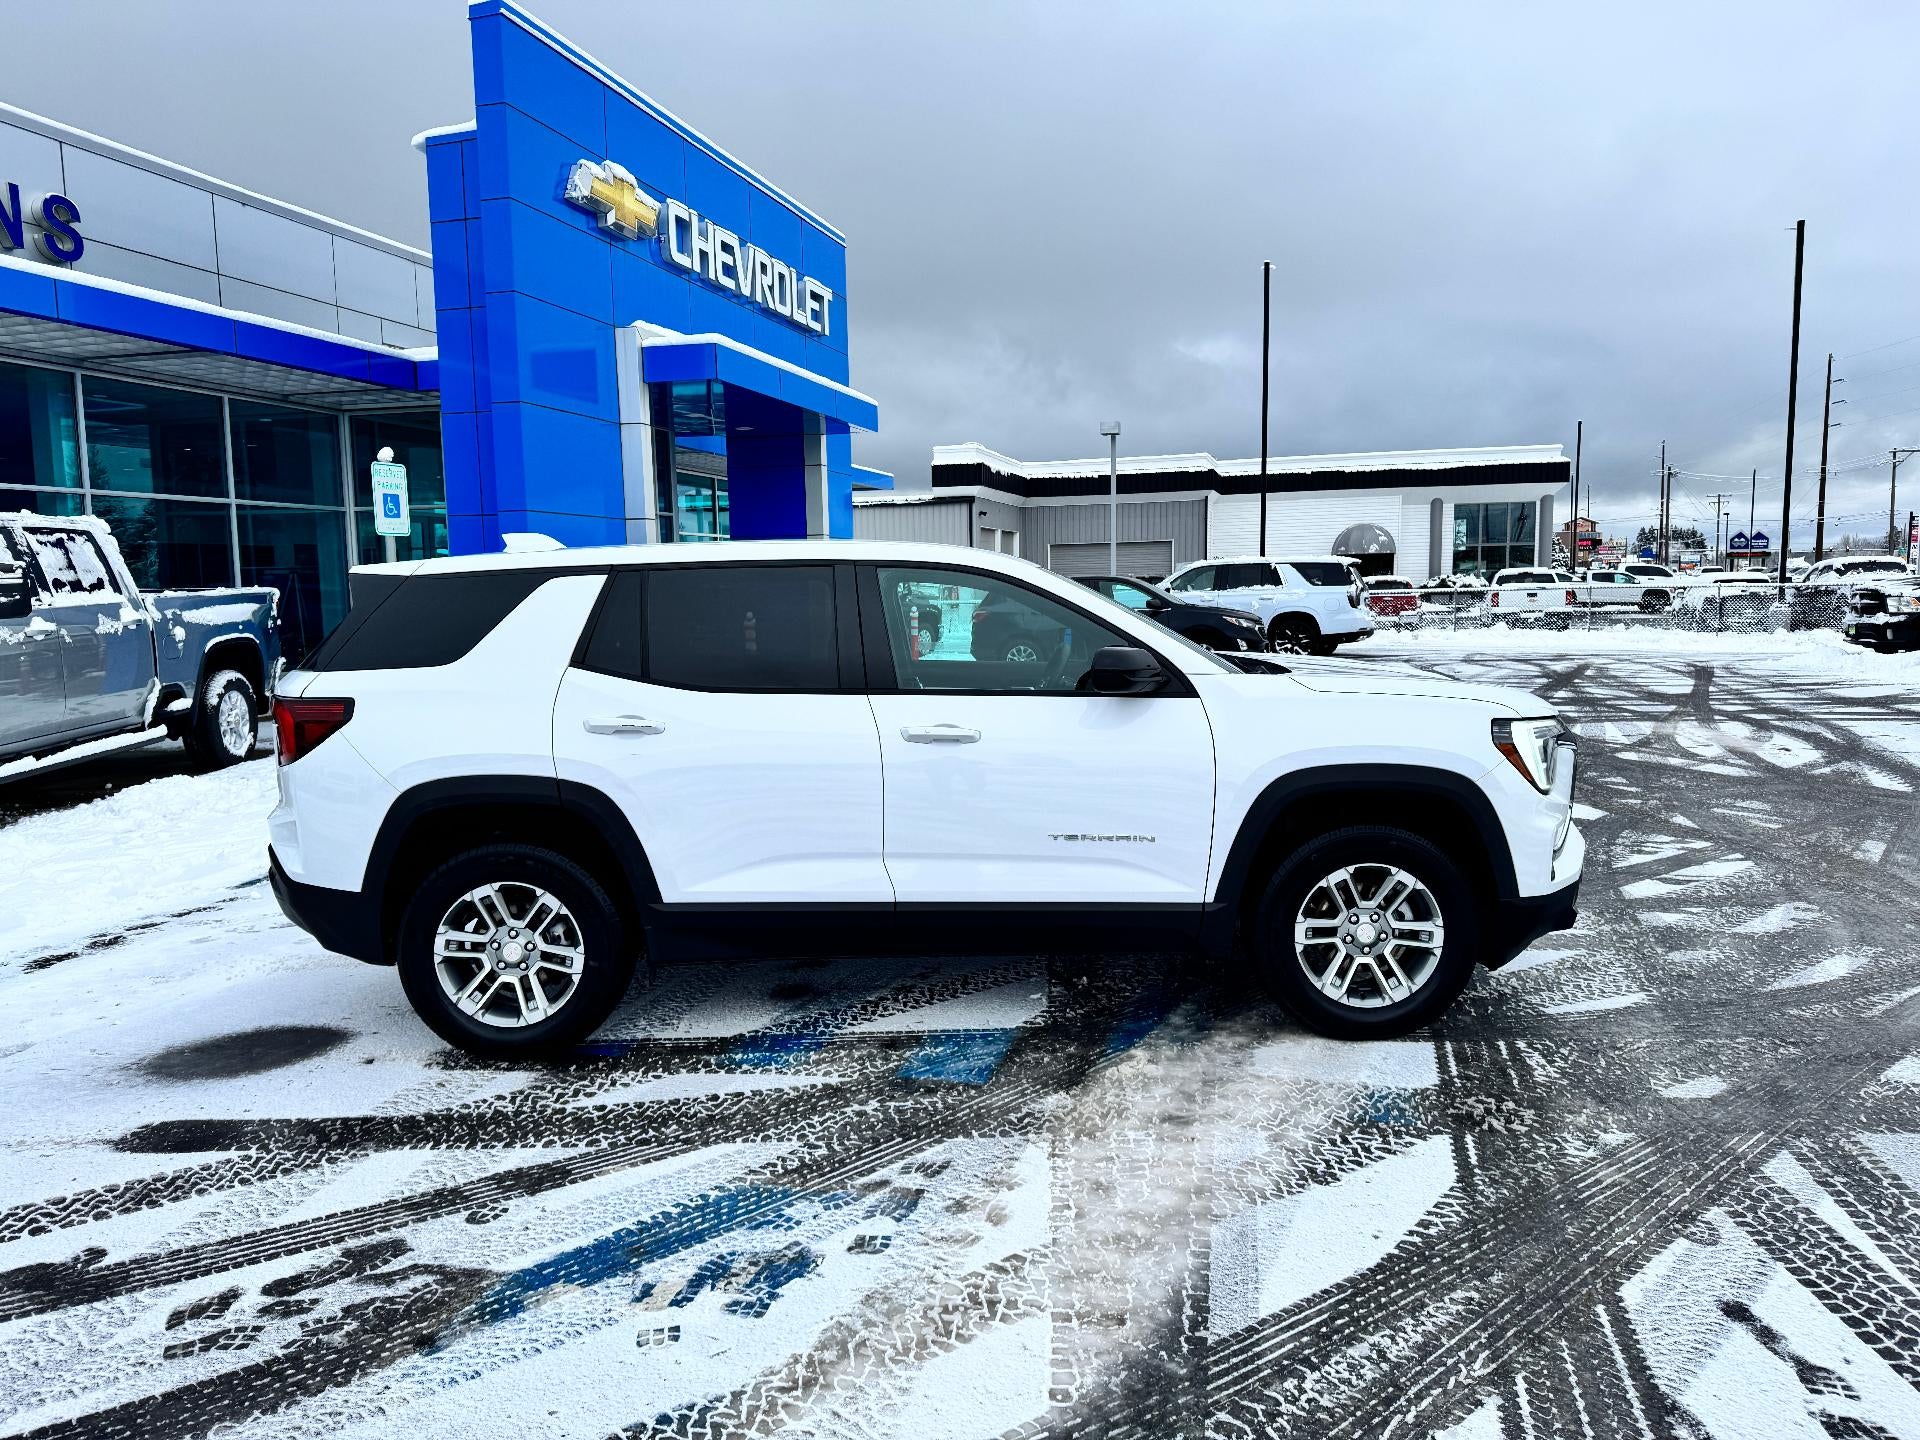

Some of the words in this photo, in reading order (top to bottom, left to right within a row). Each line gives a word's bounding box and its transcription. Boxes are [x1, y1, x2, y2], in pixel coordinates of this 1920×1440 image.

[661, 198, 832, 336] CHEVROLET
[374, 467, 403, 479] RESERVED
[376, 480, 404, 491] PARKING
[1047, 833, 1156, 843] TERRAIN
